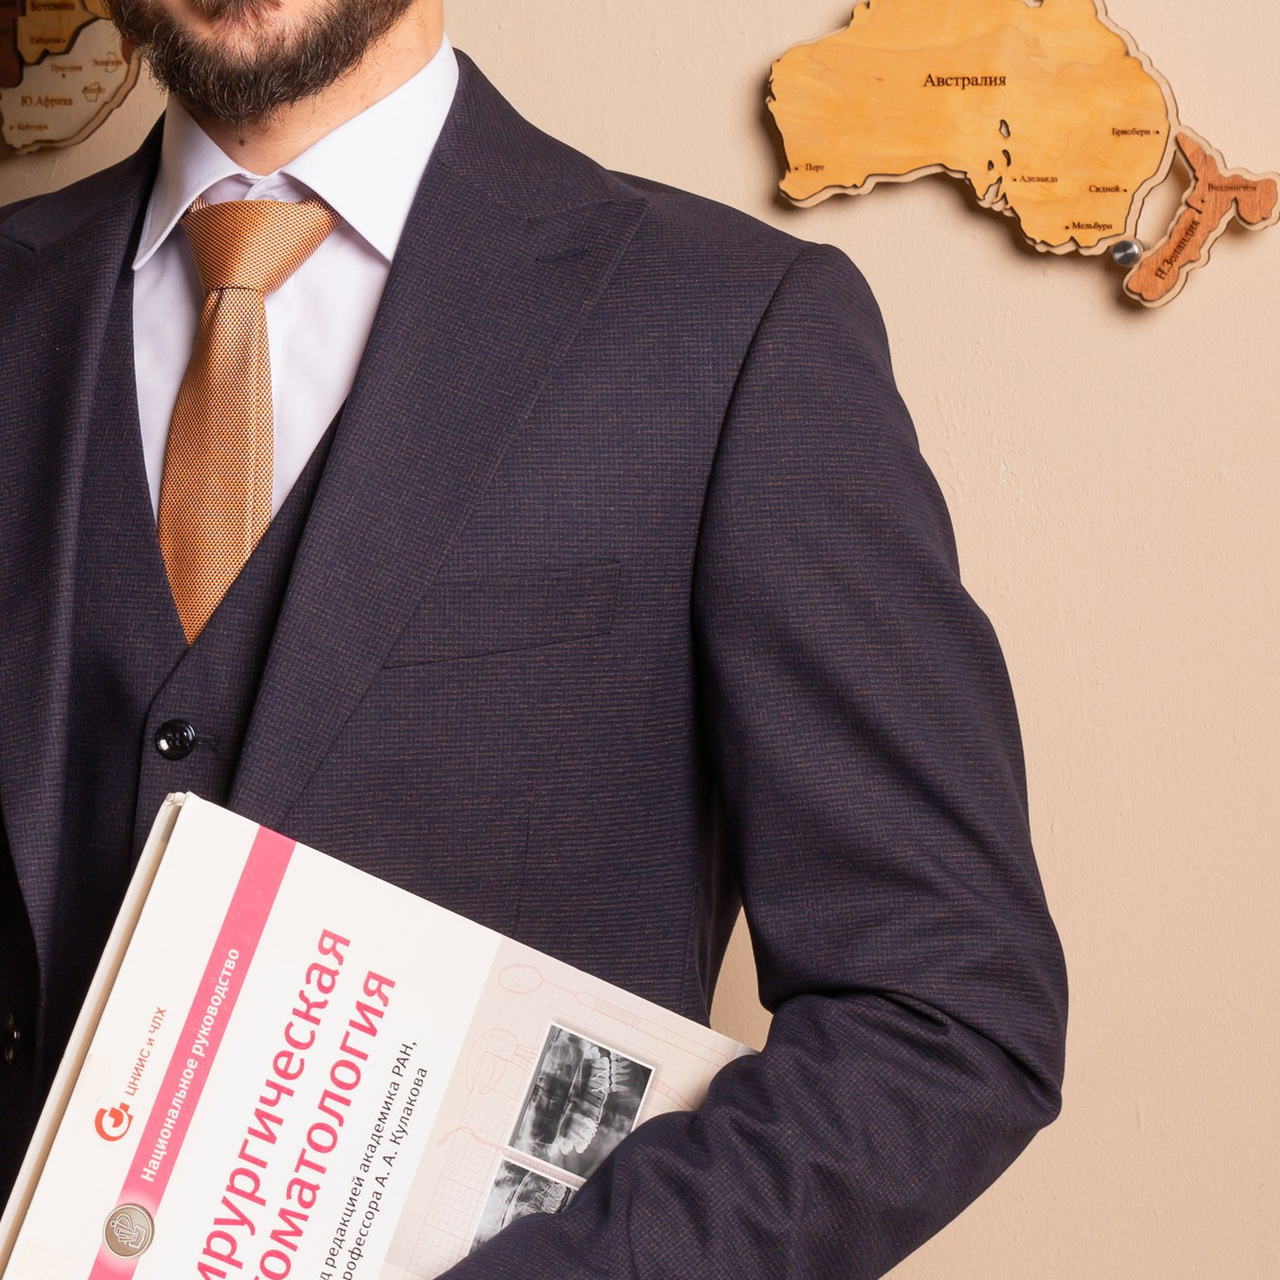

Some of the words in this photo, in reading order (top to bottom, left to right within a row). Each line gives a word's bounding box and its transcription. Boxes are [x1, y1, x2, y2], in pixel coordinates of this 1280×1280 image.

[923, 72, 1007, 91] Австралия
[804, 162, 825, 173] Перт
[1019, 174, 1059, 184] Аделаида
[1089, 183, 1121, 194] Сидней
[1072, 220, 1113, 232] Мельбурн
[125, 1048, 151, 1096] ЦНИИС
[146, 1036, 156, 1047] и
[151, 1005, 168, 1035] ЧЛХ
[141, 1058, 197, 1183] Национальное
[191, 947, 240, 1057] руководство
[389, 1067, 428, 1147] Кулакова
[325, 1176, 367, 1270] редакцией
[360, 1083, 401, 1174] академика
[392, 1039, 418, 1082] РАН,
[383, 1151, 398, 1168] А.
[381, 1171, 391, 1188] А.
